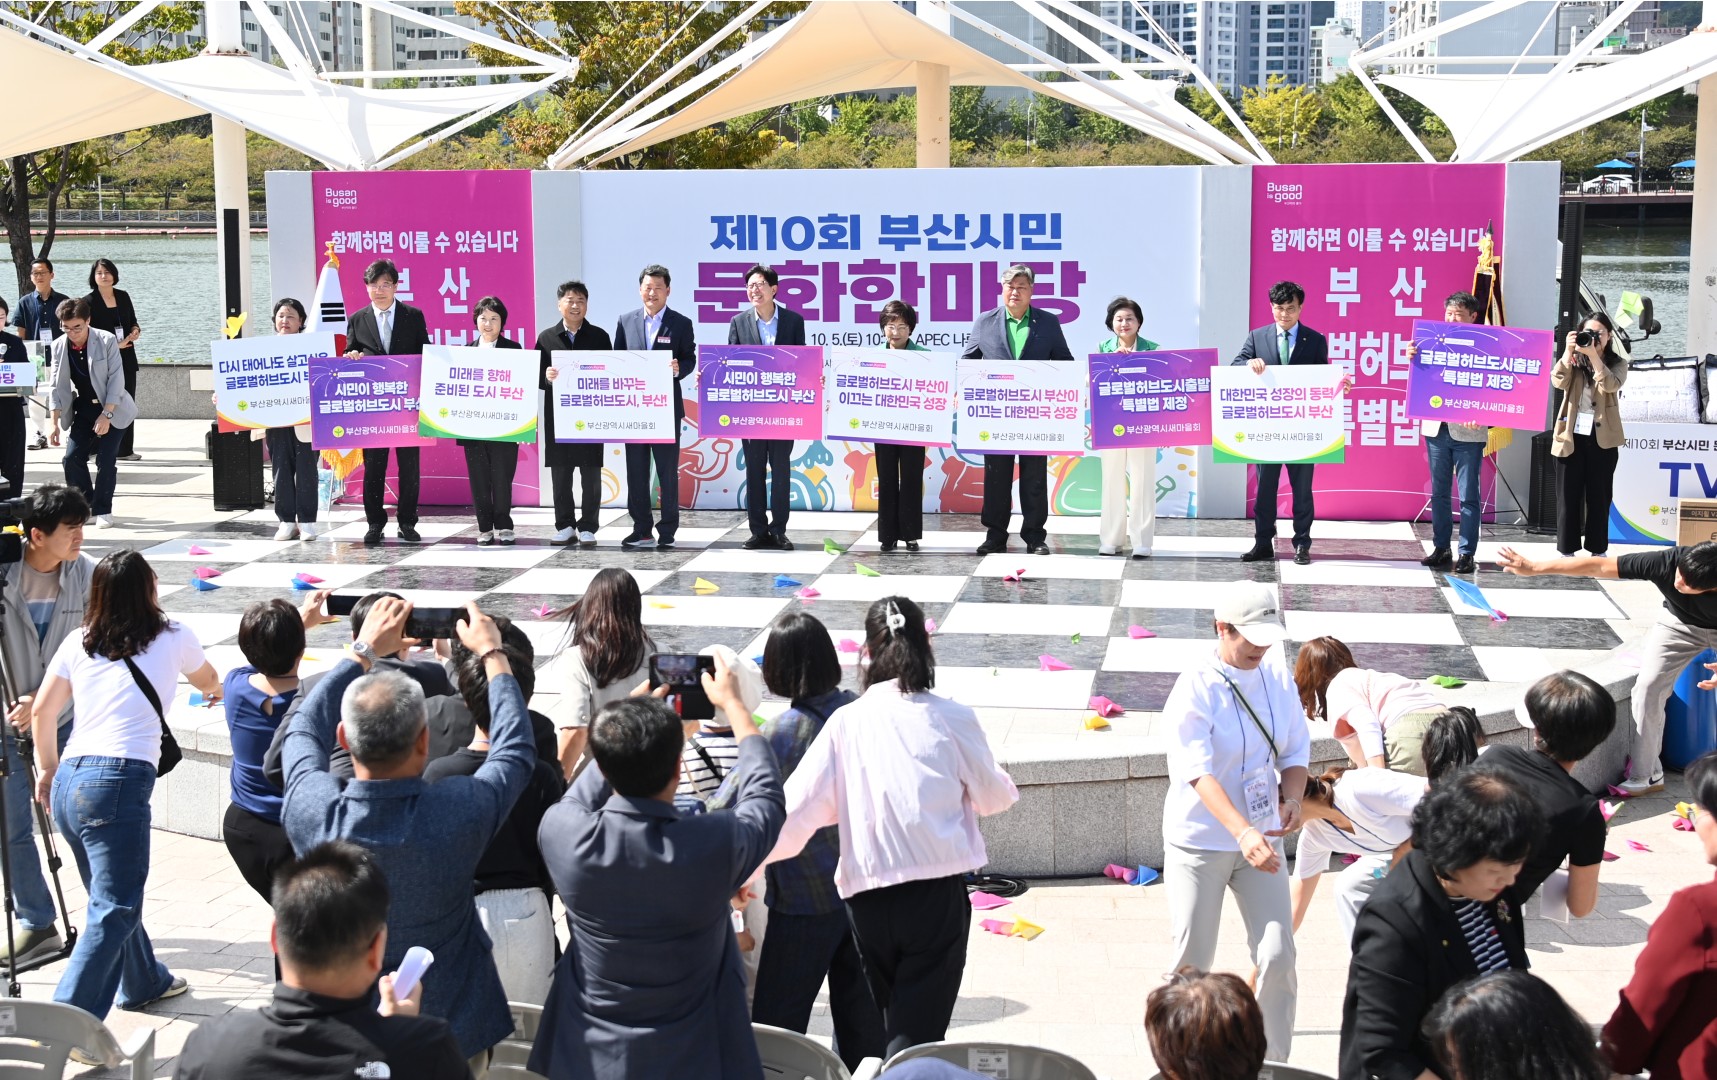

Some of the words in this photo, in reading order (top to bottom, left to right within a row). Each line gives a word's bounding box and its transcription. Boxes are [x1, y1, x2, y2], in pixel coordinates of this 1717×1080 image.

[325, 187, 357, 197] Busan
[1267, 182, 1302, 192] Busan
[332, 197, 357, 208] good
[1274, 191, 1302, 203] good
[709, 213, 861, 251] 제10회
[878, 213, 1062, 252] 부산시민
[1271, 227, 1341, 252] 함께하면
[1347, 227, 1383, 252] 이룰
[1388, 227, 1407, 252] 수
[1412, 227, 1485, 252] 있습니다
[331, 230, 394, 254] 함께하면
[398, 230, 430, 254] 이룰
[434, 231, 450, 254] 수
[455, 229, 518, 253] 있습니다
[916, 333, 950, 346] APEC
[219, 359, 240, 374] 다시
[242, 355, 285, 372] 태어나도
[1420, 349, 1541, 375] 글로벌허브도시출발
[225, 370, 302, 391] 글로벌허브도시
[449, 366, 484, 382] 미래를
[487, 368, 512, 383] 향해
[722, 371, 758, 386] 시민이
[759, 371, 797, 386] 행복한
[1443, 369, 1483, 388] 특별법
[1485, 373, 1514, 390] 제정
[335, 382, 371, 397] 시민이
[372, 381, 408, 396] 행복한
[434, 382, 470, 398] 준비된
[472, 384, 497, 399] 도시
[499, 386, 525, 401] 부산
[577, 377, 610, 391] 미래를
[612, 377, 646, 391] 바꾸는
[836, 374, 913, 392] 글로벌허브도시
[914, 379, 949, 394] 부산이
[1098, 377, 1211, 397] 글로벌허브도시출발
[559, 394, 640, 408] 글로벌허브도시,
[641, 394, 668, 408] 부산!
[706, 387, 789, 403] 글로벌허브도시
[790, 389, 816, 404] 부산
[839, 391, 873, 407] 이끄는
[875, 393, 921, 410] 대한민국
[922, 396, 948, 412] 성장
[963, 387, 1042, 402] 글로벌허브도시
[1044, 388, 1079, 403] 부산이
[1219, 387, 1268, 402] 대한민국
[1270, 387, 1307, 401] 성장의
[1309, 386, 1334, 401] 동력
[319, 397, 402, 414] 글로벌허브도시
[1122, 396, 1160, 412] 특별법
[1162, 395, 1188, 411] 제정
[1444, 398, 1525, 414] 부산광역시새마을회
[450, 409, 518, 421] 부산광역시새마을회
[967, 404, 1002, 419] 이끄는
[1004, 405, 1052, 420] 대한민국
[1053, 405, 1079, 420] 성장
[1221, 405, 1306, 420] 글로벌허브도시
[1308, 404, 1334, 419] 부산
[587, 421, 656, 430] 부산광역시새마을회
[731, 416, 804, 426] 부산광역시새마을회
[861, 420, 934, 433] 부산광역시새마을회
[1126, 422, 1201, 434] 부산광역시새마을회
[345, 424, 418, 436] 부산광역시새마을회
[991, 432, 1065, 442] 부산광역시새마을회
[1247, 432, 1323, 442] 부산광역시새마을회
[1623, 438, 1660, 450] 제10회
[1662, 438, 1710, 452] 부산시민
[1661, 505, 1678, 515] 부산
